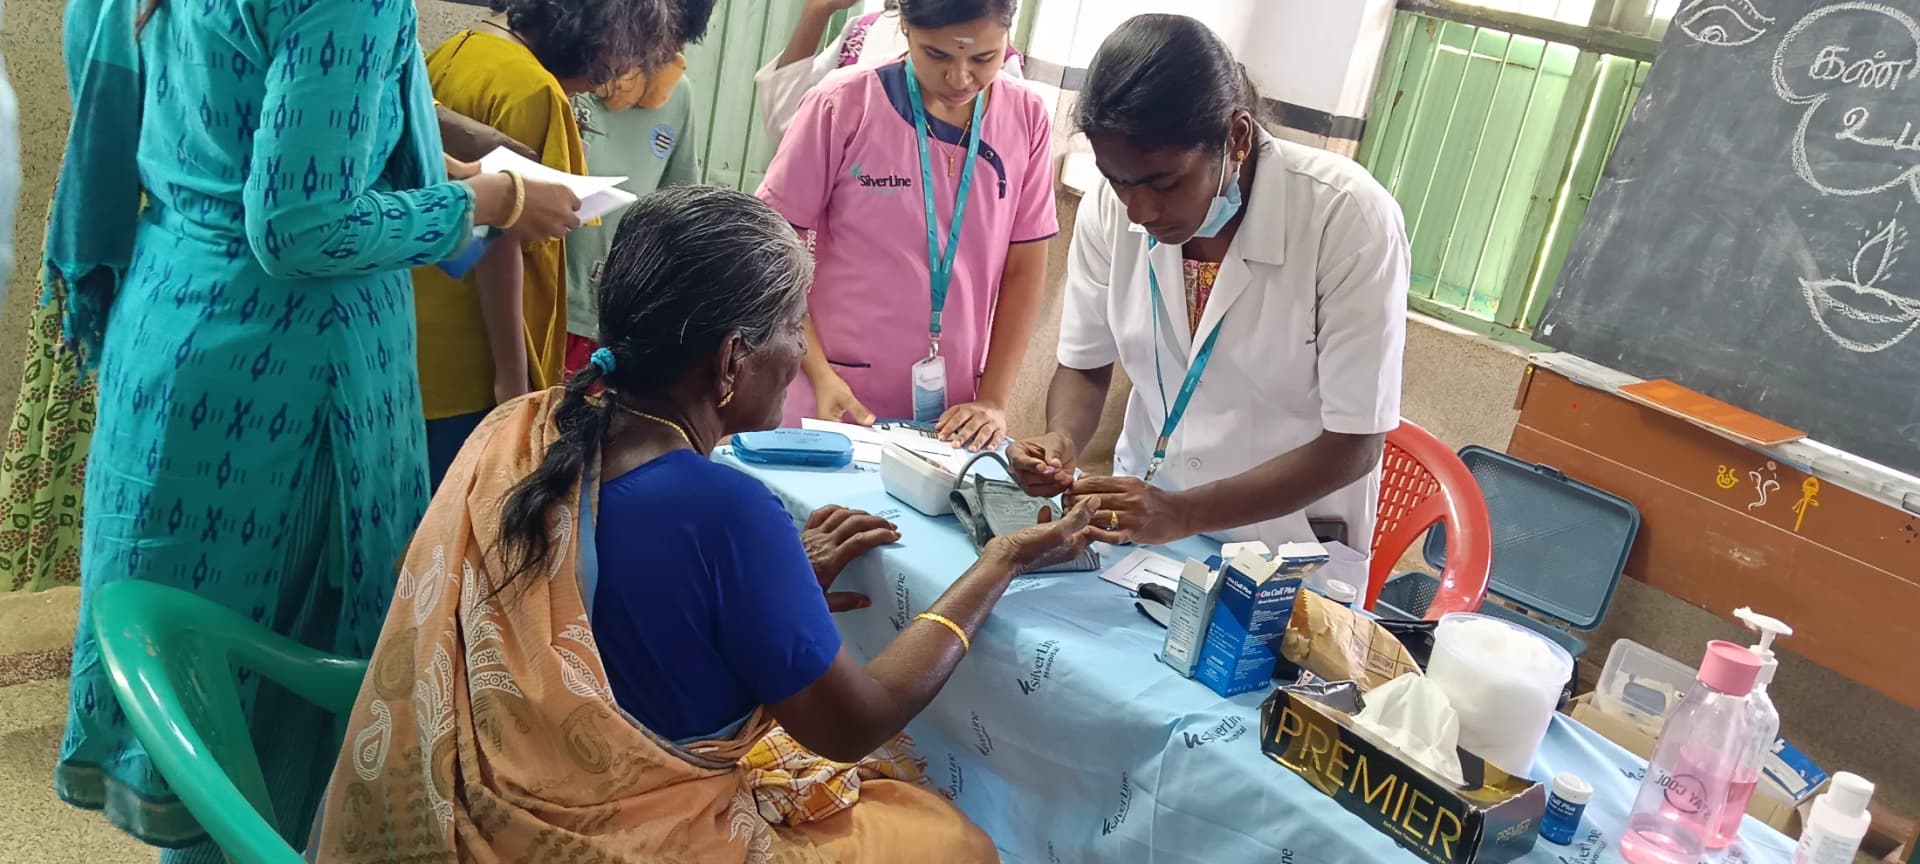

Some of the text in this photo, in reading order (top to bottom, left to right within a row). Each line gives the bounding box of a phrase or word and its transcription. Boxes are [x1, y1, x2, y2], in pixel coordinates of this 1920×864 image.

[1808, 45, 1912, 90] கண்
[859, 174, 912, 187] SilverLine
[1260, 590, 1271, 598] On
[1271, 587, 1285, 597] Call
[1284, 586, 1297, 594] Plus
[1274, 706, 1462, 860] PREMIER
[1561, 802, 1577, 813] Plus
